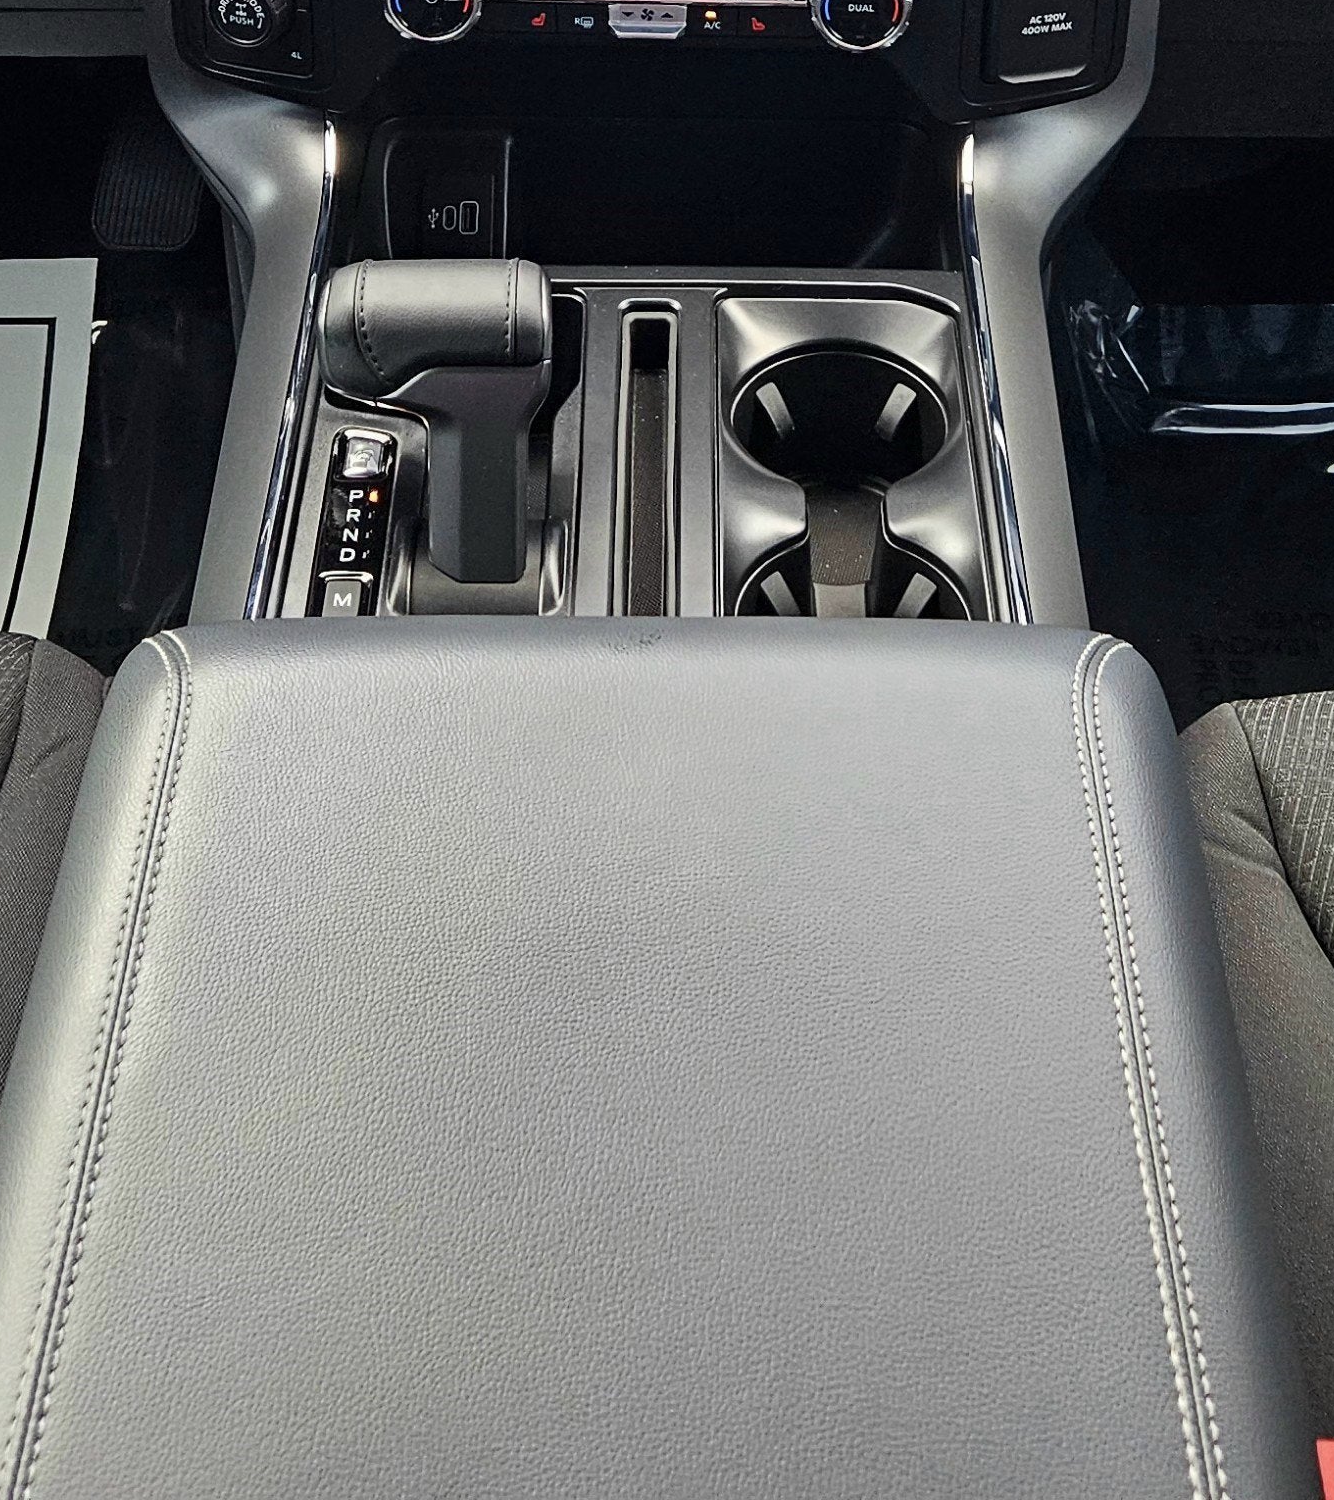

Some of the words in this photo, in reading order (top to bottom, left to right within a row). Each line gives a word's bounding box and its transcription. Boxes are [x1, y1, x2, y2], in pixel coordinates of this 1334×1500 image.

[848, 3, 875, 13] DUAL
[229, 14, 255, 26] PUSH
[1029, 15, 1042, 24] AC
[1043, 12, 1067, 24] 120V
[703, 20, 722, 31] A/C
[1021, 24, 1050, 36] 400W
[1051, 21, 1073, 33] MAX
[291, 51, 302, 60] 4L
[348, 489, 365, 503] P
[346, 508, 361, 523] R
[342, 527, 359, 542] N
[339, 547, 356, 563] D
[332, 592, 353, 607] M
